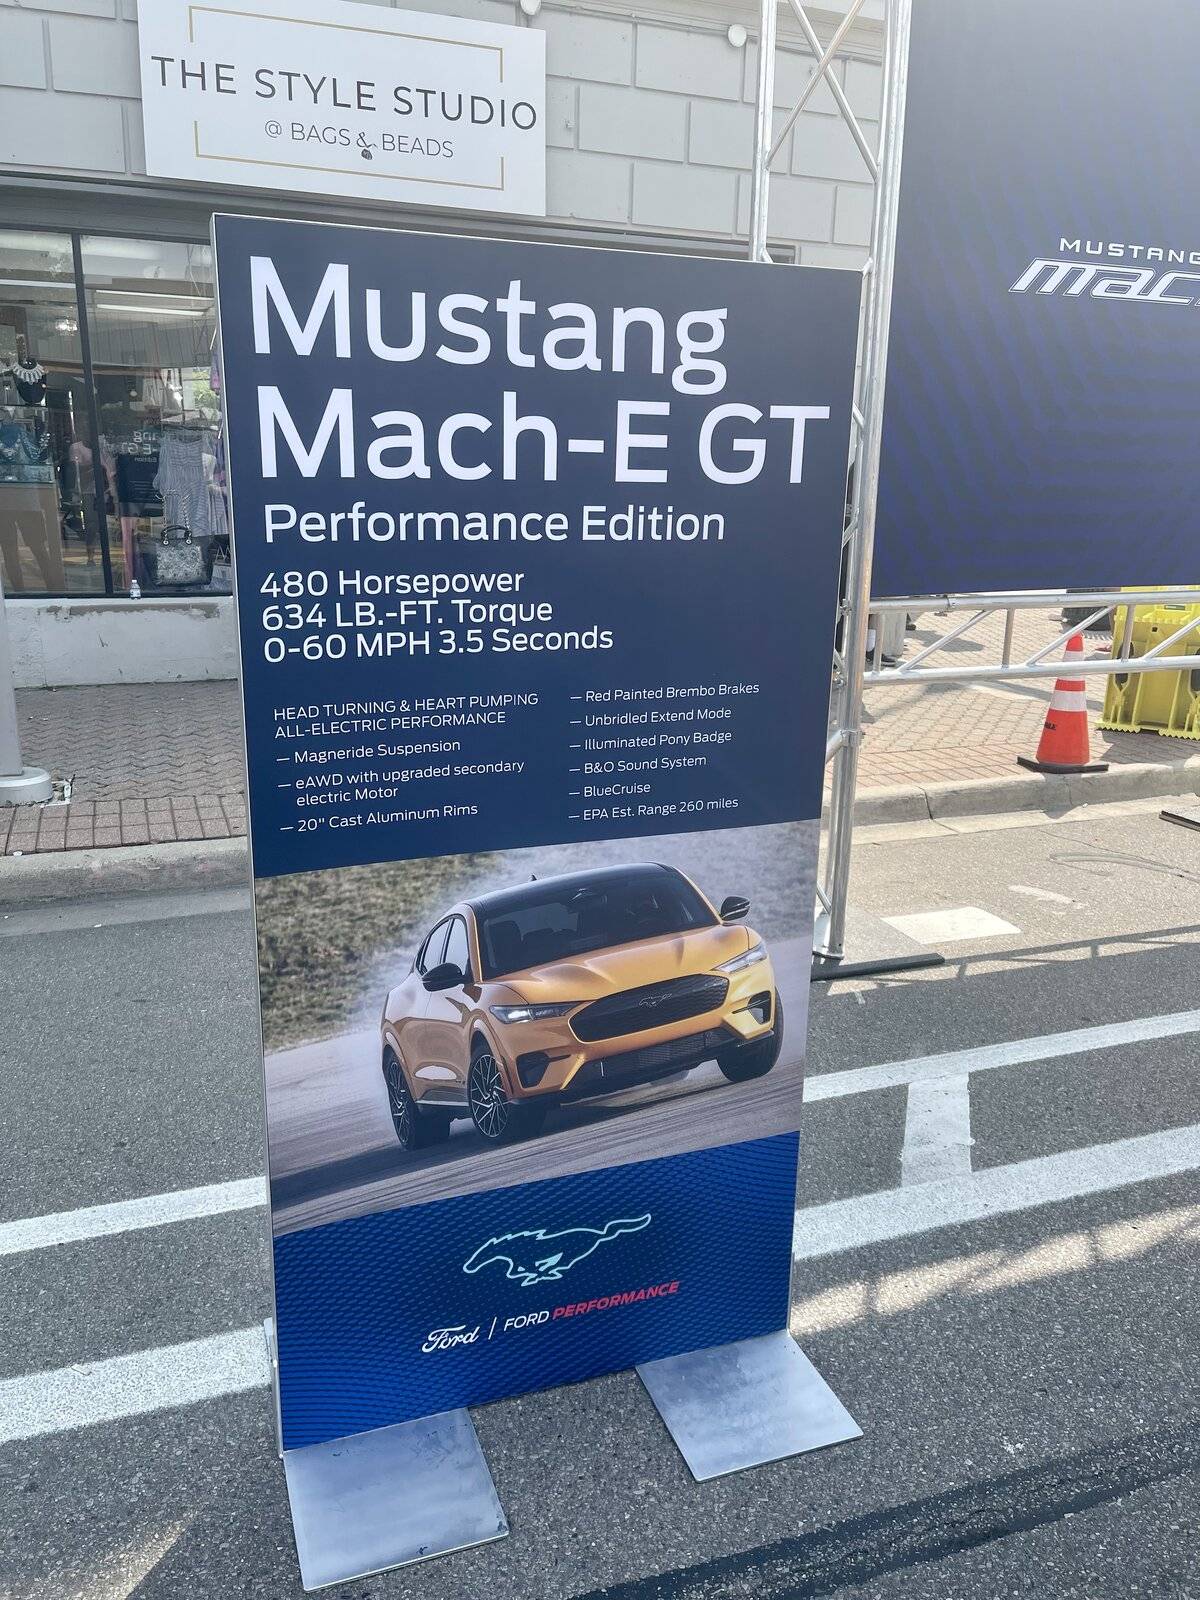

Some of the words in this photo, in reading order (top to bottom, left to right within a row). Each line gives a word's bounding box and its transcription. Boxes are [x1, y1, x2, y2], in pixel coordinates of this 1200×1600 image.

[151, 56, 237, 95] THE
[254, 68, 376, 112] STYLE
[393, 85, 537, 130] STUDIO
[264, 119, 283, 138] @
[291, 122, 351, 147] BAGS
[356, 131, 369, 148] &
[382, 133, 454, 158] BEADS
[1059, 237, 1200, 264] MUSTANG
[1008, 257, 1200, 306] mac
[250, 255, 728, 396] Mustang
[257, 385, 670, 483] Mach-E
[698, 403, 831, 485] GT
[264, 501, 569, 543] Performance
[582, 504, 726, 542] Edition
[260, 570, 328, 598] 480
[338, 571, 525, 597] Horsepower
[262, 602, 327, 631] 634
[335, 600, 443, 628] LB.-FT.
[451, 599, 553, 625] Torque
[264, 634, 346, 663] 0-60
[356, 631, 431, 658] MPH
[438, 629, 484, 654] 3.5
[491, 626, 614, 653] Seconds
[585, 690, 611, 702] Red
[614, 687, 663, 701] Painted
[666, 684, 716, 698] Brembo
[718, 682, 760, 696] Brakes
[274, 705, 320, 721] HEAD
[323, 700, 396, 717] TURNING
[399, 699, 411, 712] &
[415, 697, 466, 711] HEART
[469, 693, 539, 708] PUMPING
[585, 712, 648, 727] Unbridled
[651, 708, 694, 723] Extend
[697, 707, 732, 719] Mode
[274, 718, 387, 739] ALL-ELECTRIC
[391, 711, 506, 730] PERFORMANCE
[294, 746, 374, 764] Magneride
[377, 740, 461, 758] Suspension
[585, 734, 656, 750] Illuminated
[659, 734, 690, 749] Pony
[693, 731, 732, 744] Badge
[295, 773, 343, 790] eAWD
[347, 771, 379, 784] with
[382, 764, 450, 782] upgraded
[453, 760, 525, 776] secondary
[584, 761, 614, 774] B&O
[617, 757, 658, 772] Sound
[661, 755, 707, 770] System
[296, 791, 351, 807] electric
[355, 787, 398, 800] Motor
[584, 782, 651, 797] BlueCruise
[297, 818, 325, 833] 20"
[329, 813, 363, 829] Cast
[366, 806, 440, 825] Aluminum
[443, 803, 479, 817] Rims
[583, 808, 608, 820] EPA
[612, 806, 635, 818] Est.
[638, 803, 677, 816] Range
[679, 801, 704, 812] 260
[707, 798, 739, 809] miles
[503, 1310, 550, 1331] FORD
[552, 1281, 680, 1320] PERFORMANCE
[421, 1325, 480, 1353] Ford
